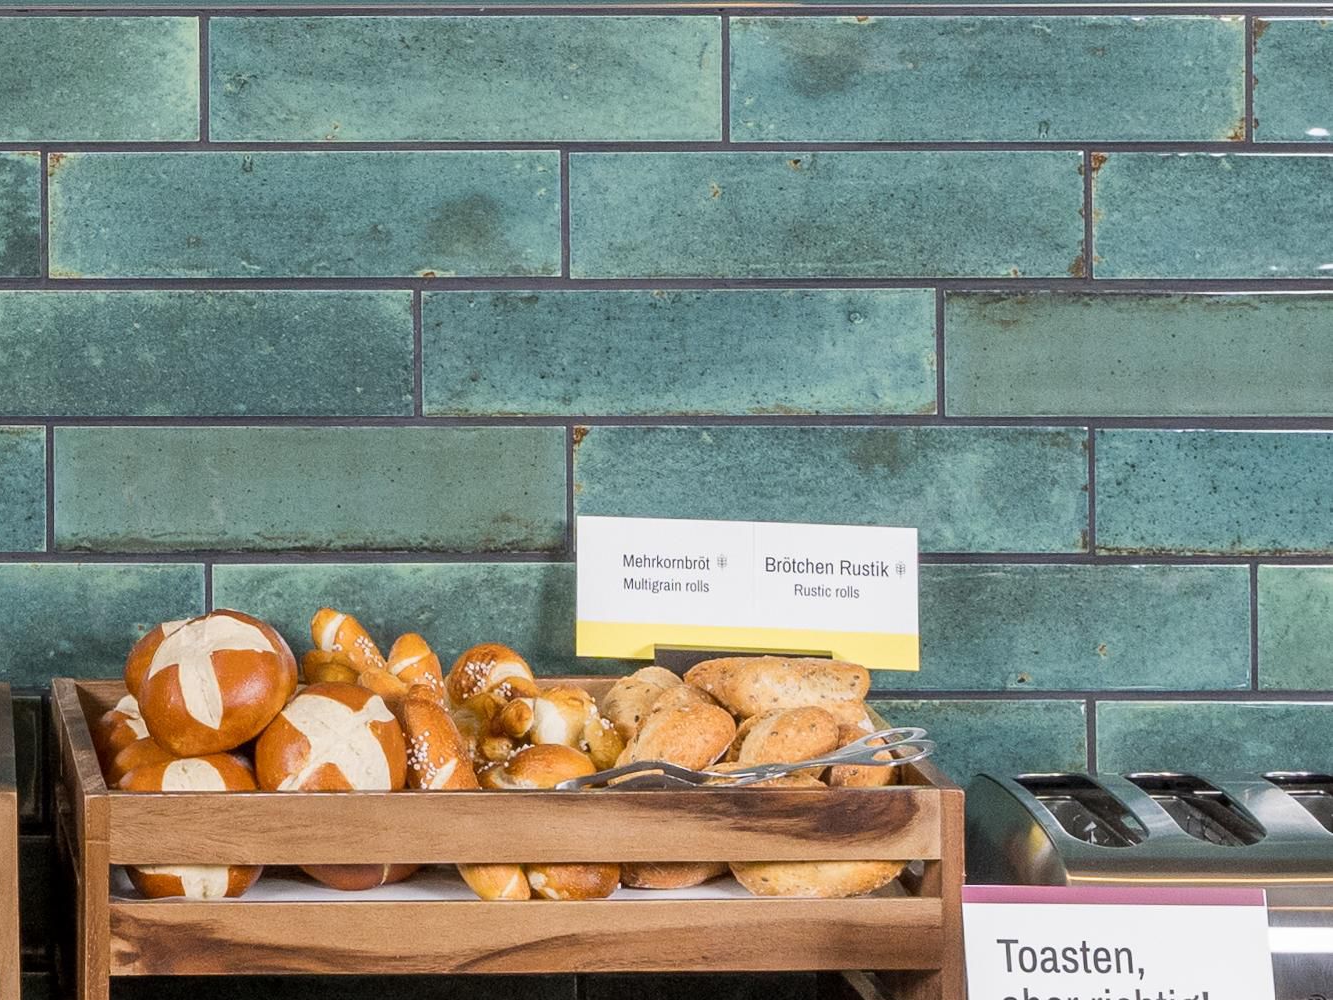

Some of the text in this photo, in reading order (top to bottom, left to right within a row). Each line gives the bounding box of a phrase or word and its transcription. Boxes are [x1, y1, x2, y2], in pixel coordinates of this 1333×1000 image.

[765, 556, 889, 577] Brötchen Rustik
[623, 577, 710, 594] Multigrain rolls
[794, 583, 860, 599] Rustic rolls
[996, 938, 1145, 981] Toasten,
